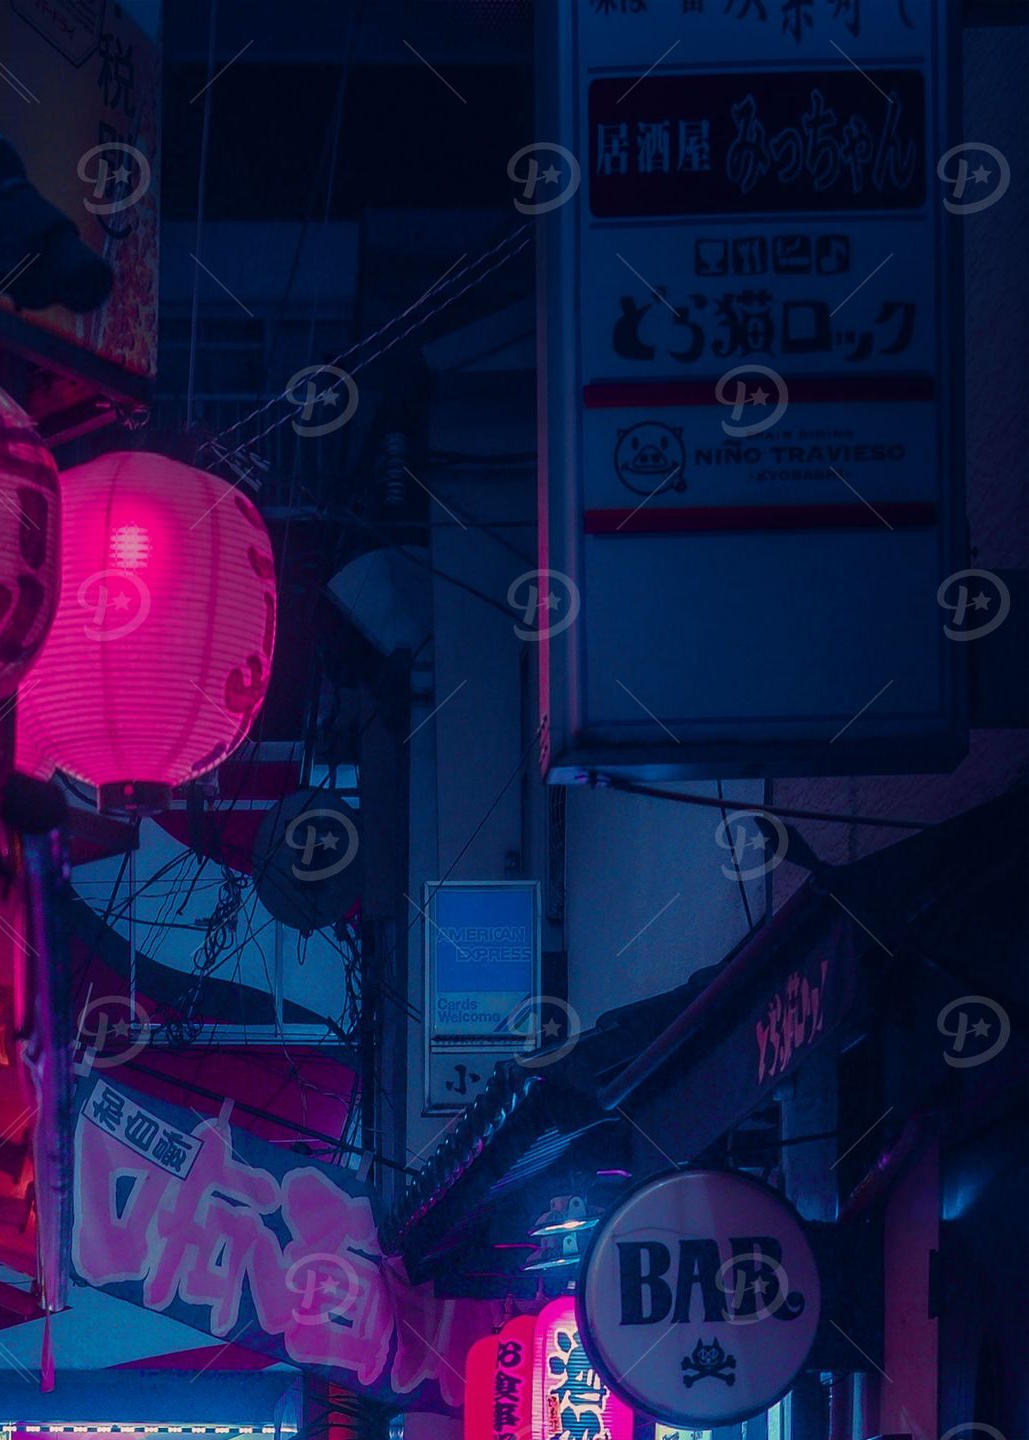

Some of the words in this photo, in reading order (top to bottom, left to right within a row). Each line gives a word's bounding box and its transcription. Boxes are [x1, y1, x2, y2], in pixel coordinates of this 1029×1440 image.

[596, 119, 714, 176] 居酒屋
[612, 286, 916, 363] どら猫ロック
[769, 444, 907, 464] TRAVIESO
[436, 926, 527, 944] AMERICAN
[456, 945, 533, 963] EXPRESS
[437, 997, 479, 1011] Cards
[437, 1010, 502, 1024] Welcome
[616, 1236, 806, 1326] BAR
